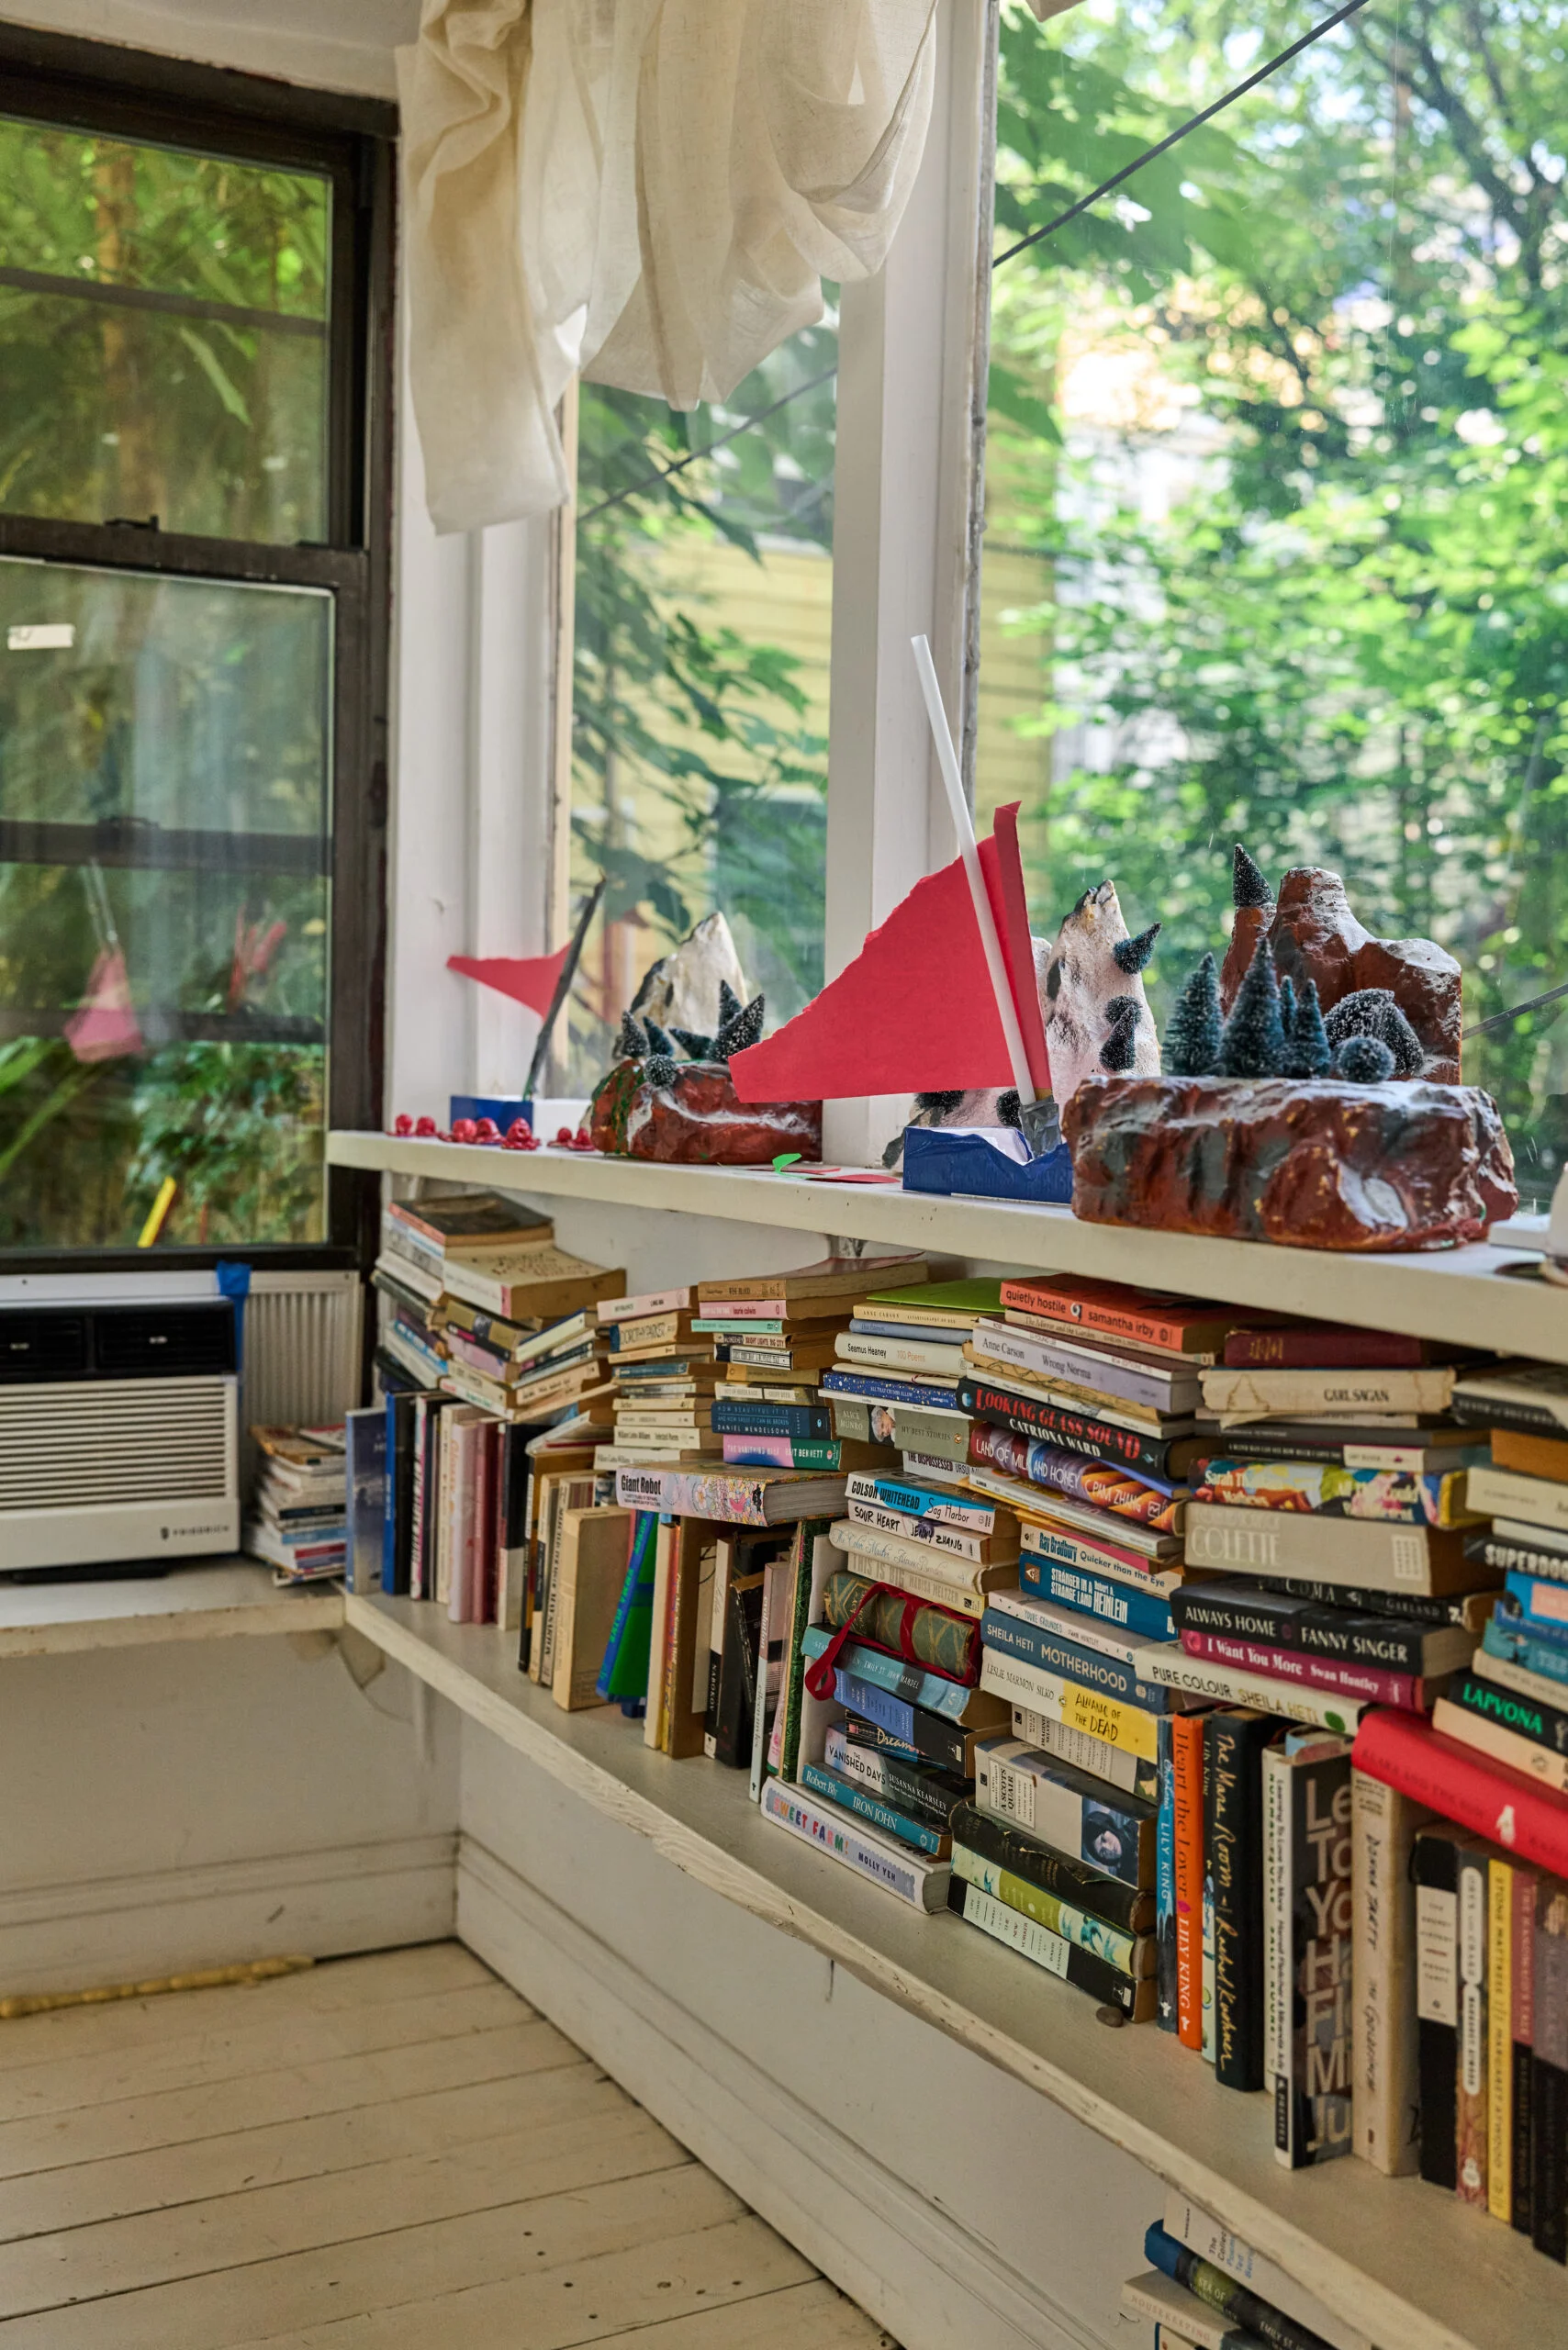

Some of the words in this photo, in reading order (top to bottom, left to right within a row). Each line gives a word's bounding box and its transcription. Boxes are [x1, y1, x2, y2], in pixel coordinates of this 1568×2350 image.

[879, 1311, 900, 1319] CARSON
[1005, 1290, 1035, 1307] quietly
[1037, 1297, 1066, 1313] hostile
[1089, 1311, 1133, 1331] samantha
[1136, 1323, 1154, 1338] irby
[847, 1344, 867, 1354] Seamus
[868, 1347, 887, 1359] Heaney
[897, 1349, 905, 1359] 100
[907, 1352, 925, 1362] Poems
[982, 1337, 1000, 1352] Anne
[1001, 1341, 1025, 1360] Carson
[1042, 1354, 1065, 1375] Wrong
[1067, 1361, 1092, 1380] Norma
[843, 1410, 860, 1420] ALICE
[1324, 1388, 1350, 1403] CARL
[1353, 1390, 1389, 1403] SAGAN
[745, 1427, 790, 1435] MENDELSOHN
[840, 1420, 864, 1431] MUNRO
[902, 1426, 910, 1434] MY
[912, 1428, 925, 1437] BEST
[926, 1431, 951, 1440] STORIES
[976, 1388, 1036, 1422] LOOKING
[1039, 1408, 1083, 1438] GLASS
[1086, 1417, 1141, 1460] SOUND
[1010, 1418, 1064, 1449] CATRIONA
[1067, 1438, 1101, 1458] WARD
[799, 1449, 823, 1459] BENNETT
[908, 1453, 917, 1463] THE
[918, 1454, 953, 1472] DISPOSSESSED
[622, 1475, 639, 1492] Giant
[641, 1477, 661, 1494] Robot
[976, 1438, 994, 1459] LAND
[995, 1447, 1010, 1462] OF
[1033, 1460, 1047, 1477] AND
[1050, 1468, 1081, 1490] HONEY
[1092, 1483, 1112, 1502] PAM
[1114, 1489, 1142, 1513] ZHANG
[851, 1481, 878, 1499] COLSON
[879, 1489, 921, 1510] WHITEHEAD
[927, 1497, 941, 1519] Sag
[946, 1505, 969, 1523] Harbor
[854, 1505, 874, 1523] SOUR
[877, 1516, 901, 1532] HEART
[911, 1524, 935, 1543] JENNY
[935, 1536, 963, 1551] ZHANG
[1039, 1533, 1050, 1550] Ray
[1191, 1526, 1282, 1566] COLETTE
[853, 1555, 874, 1575] THIS
[876, 1562, 885, 1579] IS
[889, 1567, 905, 1587] BIG
[933, 1583, 959, 1604] MELTZER
[1051, 1568, 1080, 1588] STRANGER
[1081, 1579, 1088, 1590] IN
[1088, 1581, 1092, 1594] A
[1081, 1551, 1111, 1568] Quicker
[1114, 1562, 1133, 1576] than
[1134, 1570, 1148, 1582] the
[1150, 1577, 1165, 1587] Eye
[1051, 1582, 1076, 1602] STRANGE
[1077, 1591, 1092, 1607] LAND
[1093, 1591, 1128, 1624] HEINLEIN
[759, 1595, 770, 1650] evolution
[1185, 1606, 1232, 1630] ALWAYS
[1235, 1615, 1277, 1638] HOME
[1301, 1627, 1349, 1651] FANNY
[1352, 1637, 1408, 1662] SINGER
[864, 1661, 879, 1673] EMILY
[888, 1669, 900, 1682] JOHN
[901, 1675, 920, 1689] MANDEL
[987, 1624, 1014, 1644] SHEILA
[1015, 1633, 1034, 1652] HETI
[1041, 1644, 1127, 1693] MOTHERHOOD
[1207, 1638, 1214, 1652] I
[1217, 1639, 1244, 1661] Want
[1248, 1645, 1269, 1668] You
[1272, 1657, 1303, 1676] More
[1311, 1664, 1337, 1682] Swan
[1339, 1671, 1379, 1694] Huntley
[708, 1664, 718, 1712] NABOKOV
[987, 1663, 1005, 1680] LESLIE
[1006, 1672, 1034, 1692] MARMON
[1036, 1684, 1054, 1700] SILKO
[1153, 1666, 1181, 1684] PURE
[1182, 1674, 1232, 1698] COLOUR
[1238, 1689, 1284, 1715] SHEILA
[1286, 1702, 1319, 1723] HETI
[1075, 1713, 1087, 1724] THE
[1090, 1715, 1118, 1741] DEAD
[1112, 1709, 1121, 1719] OF
[1462, 1683, 1543, 1735] LAPVONA
[853, 1751, 861, 1760] THE
[1175, 1731, 1191, 1790] Heart
[1217, 1732, 1235, 1764] The
[828, 1744, 865, 1773] VANISHED
[866, 1766, 886, 1785] DAYS
[889, 1773, 915, 1794] SUSANNA
[916, 1786, 947, 1810] KEARSLEY
[1215, 1770, 1238, 1818] Mars
[806, 1770, 826, 1790] Robert
[826, 1782, 838, 1799] Bly
[852, 1796, 873, 1816] IRON
[873, 1807, 897, 1830] JOHN
[773, 1797, 808, 1830] SWEET
[812, 1819, 849, 1855] FARM!
[858, 1852, 879, 1873] MOLLY
[882, 1866, 896, 1882] YEH
[1160, 1822, 1171, 1857] LILY
[1176, 1807, 1192, 1833] the
[1176, 1837, 1192, 1898] Lover
[1213, 1823, 1237, 1889] Room
[1159, 1861, 1170, 1900] KING
[1177, 1917, 1191, 1958] LILY
[1215, 1918, 1239, 1984] Rachel
[1178, 1961, 1191, 2009] KING
[1218, 1987, 1238, 2071] Kushner
